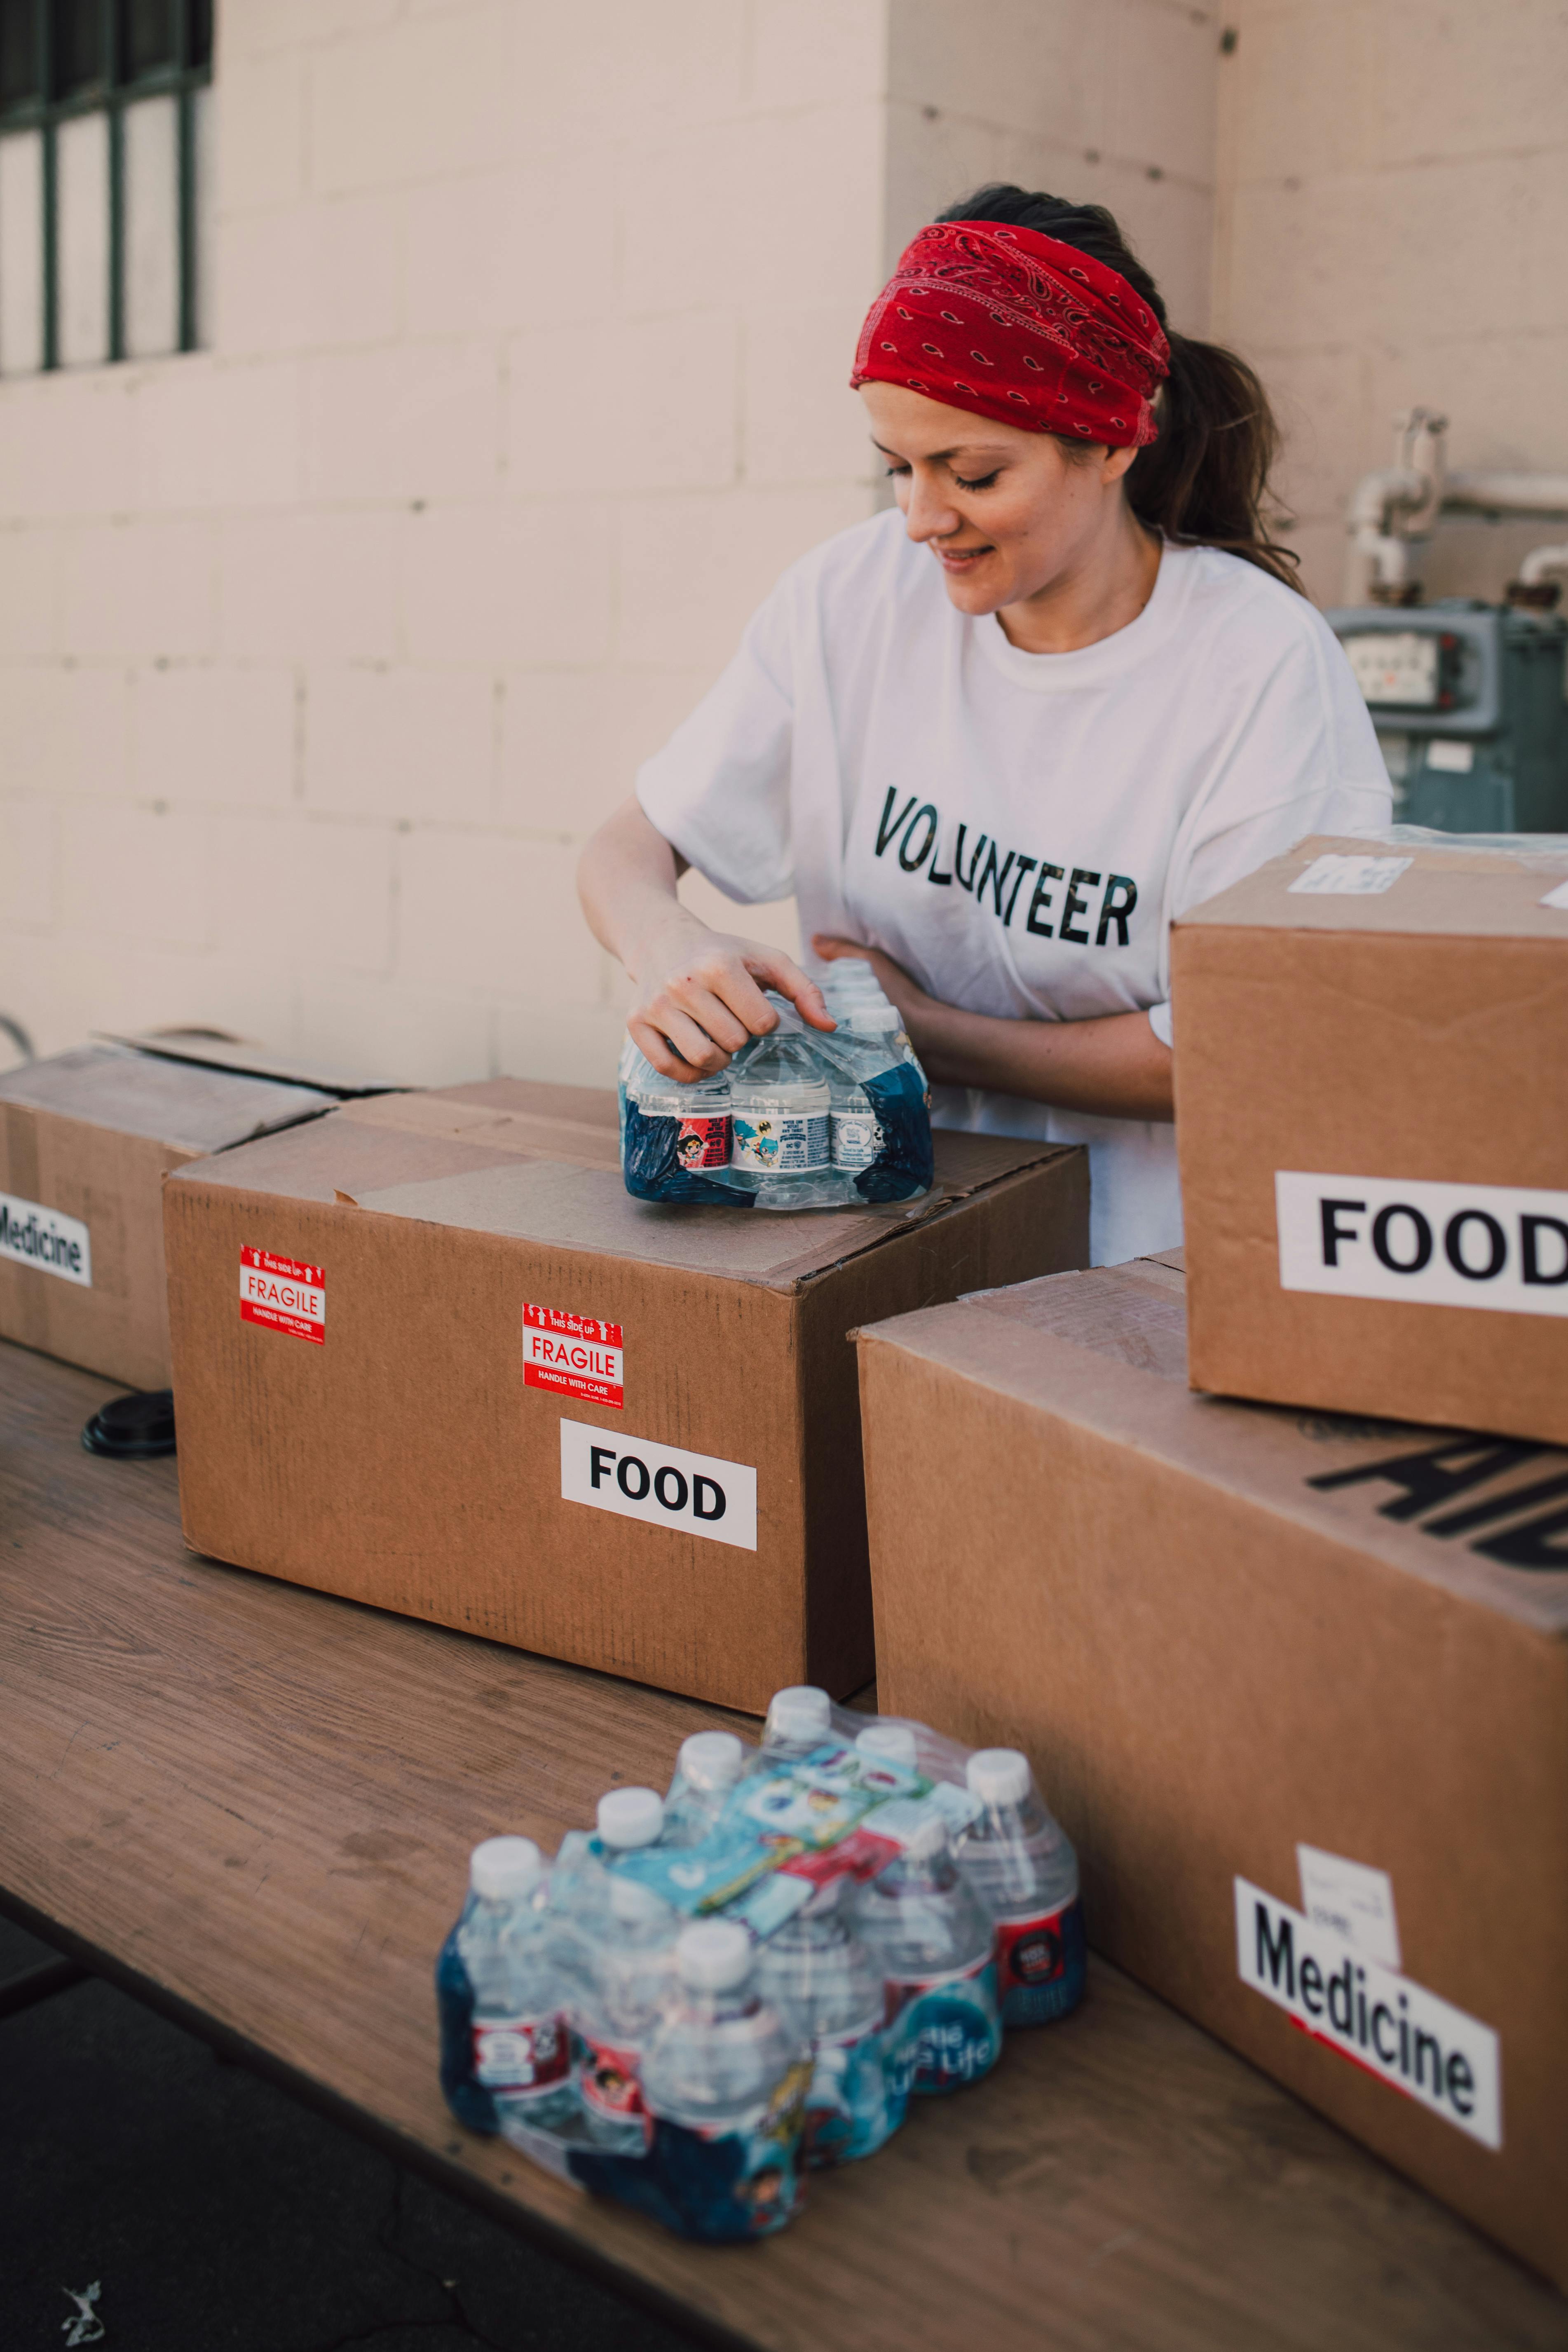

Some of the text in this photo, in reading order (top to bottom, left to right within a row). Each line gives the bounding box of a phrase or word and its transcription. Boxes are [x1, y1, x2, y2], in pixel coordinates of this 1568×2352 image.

[875, 786, 1138, 946] VOLUNTEER
[1320, 1198, 1568, 1287] FOOD
[264, 1258, 277, 1270] THIS
[278, 1262, 292, 1274] SIDE
[249, 1277, 317, 1315] FRAGILE
[253, 1306, 312, 1332] HANDLE WITH CARE
[551, 1317, 595, 1335] THIS SIDE UP
[533, 1336, 614, 1377] FRAGILE
[538, 1370, 608, 1395] HANDLE WITH CARE
[591, 1445, 727, 1521] FOOD
[1254, 1901, 1474, 2116] Medicine
